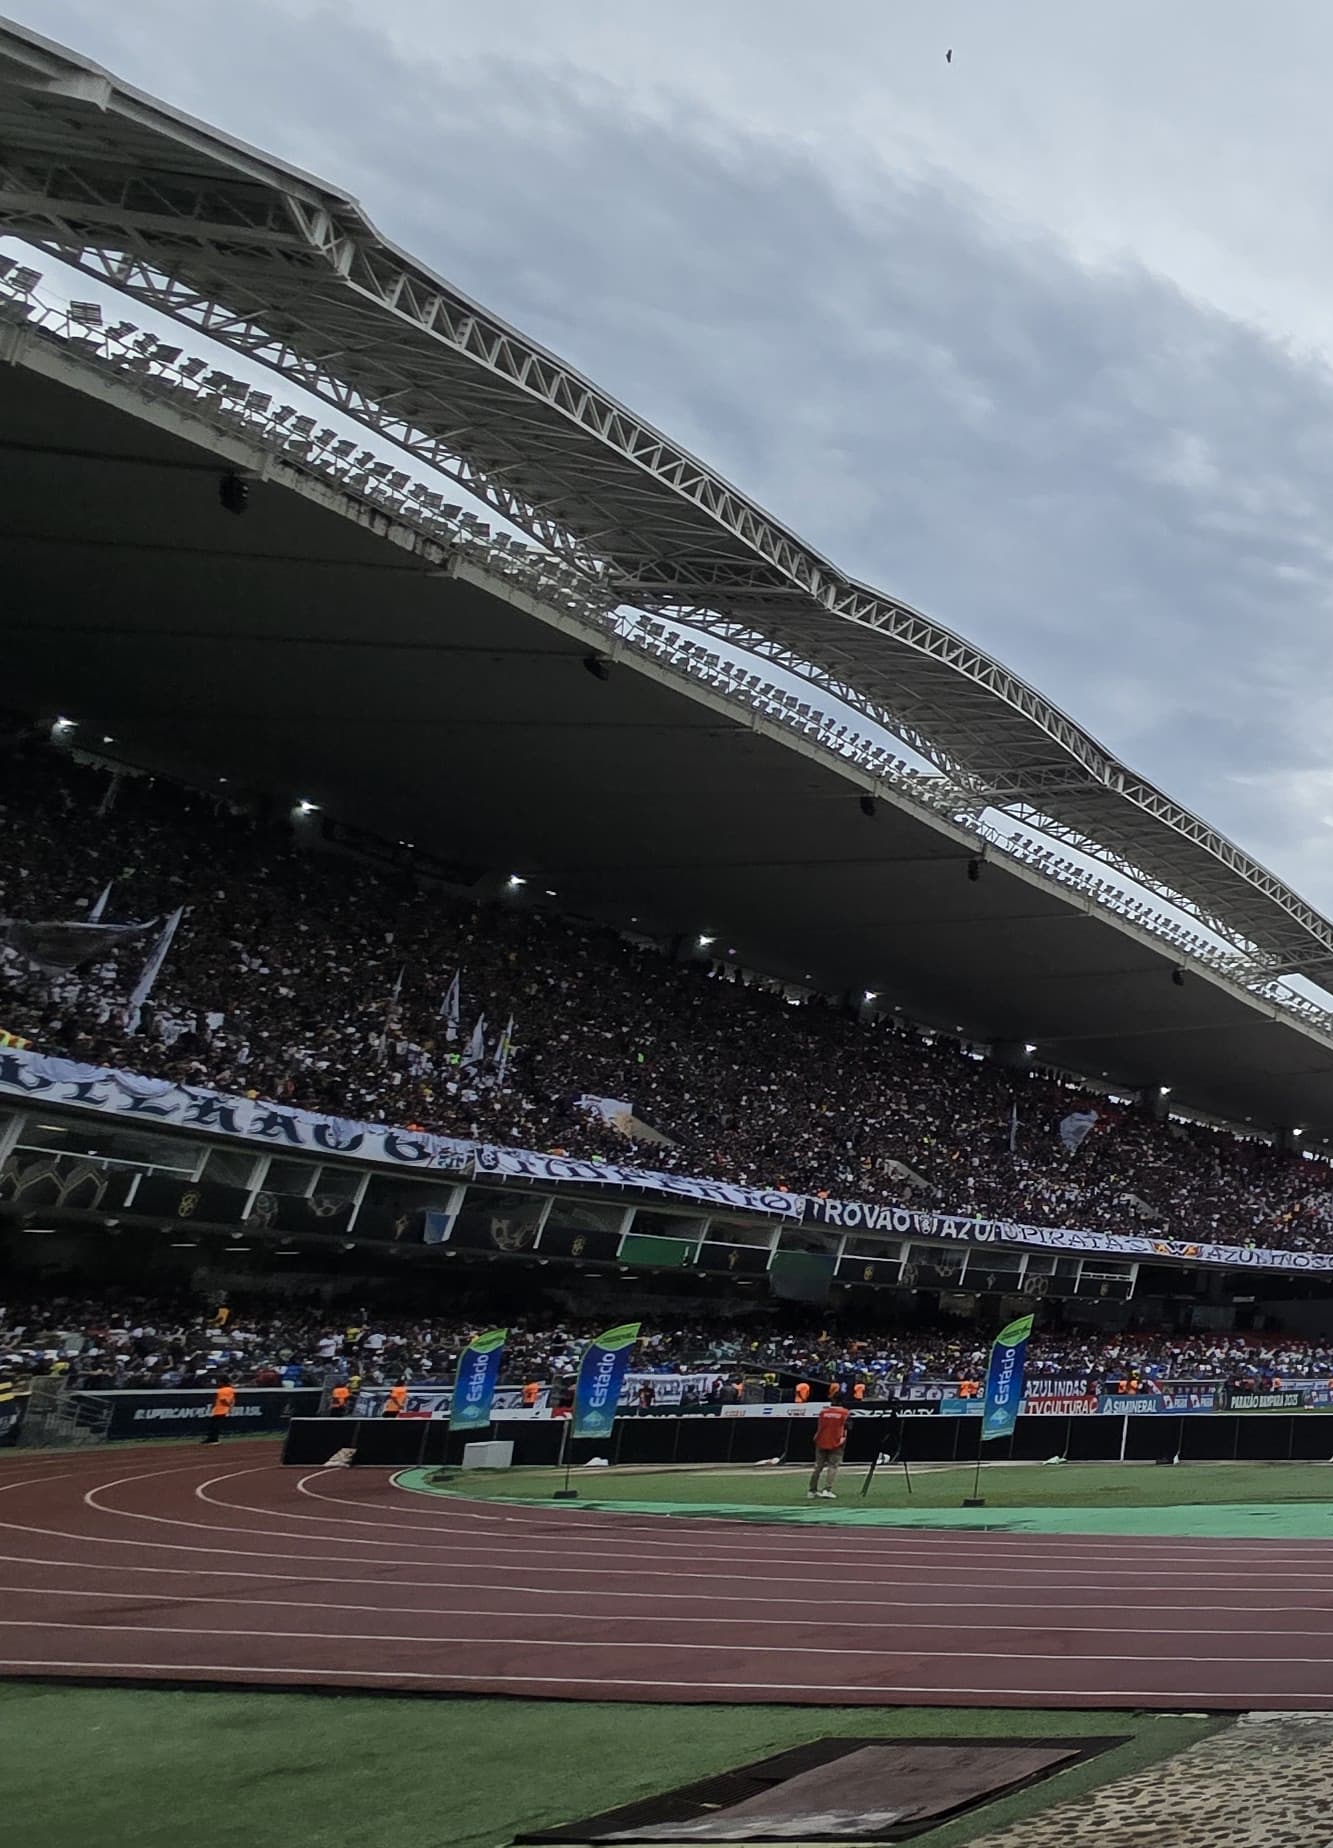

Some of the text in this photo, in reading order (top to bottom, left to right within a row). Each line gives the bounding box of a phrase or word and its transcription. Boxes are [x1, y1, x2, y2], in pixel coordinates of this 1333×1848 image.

[1025, 1226, 1328, 1270] PIRATAS AZULINOS
[466, 1354, 489, 1402] Estácio
[589, 1353, 616, 1408] Estácio
[994, 1348, 1016, 1405] Estácio
[1024, 1379, 1088, 1398] AZULINDAS
[1028, 1400, 1090, 1414] TV CULTURA
[1113, 1399, 1157, 1413] SIMINERAL
